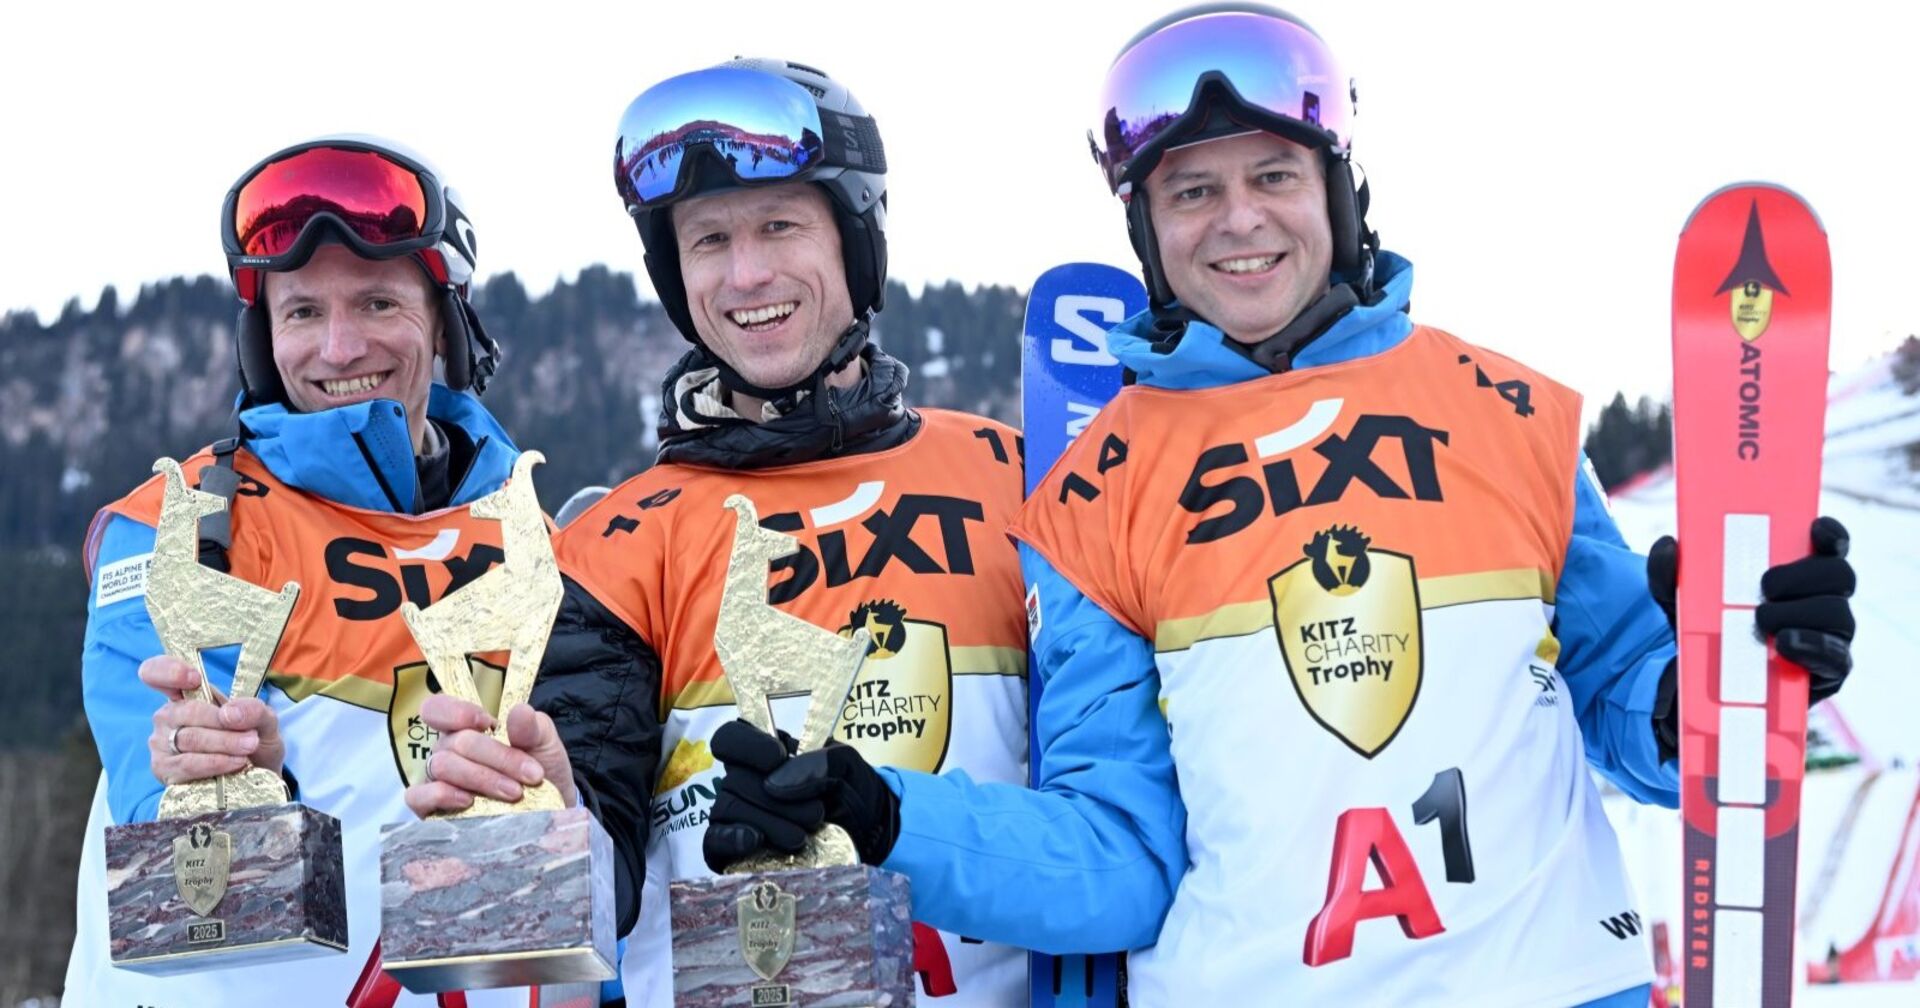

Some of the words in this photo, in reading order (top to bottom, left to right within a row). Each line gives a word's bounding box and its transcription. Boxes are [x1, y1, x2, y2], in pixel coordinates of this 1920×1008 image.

[1738, 341, 1762, 461] ATOMIC
[102, 571, 114, 581] FIS
[114, 562, 143, 577] ALPINE
[102, 576, 129, 590] WORLD
[1299, 616, 1358, 643] KITZ
[1304, 632, 1410, 664] CHARITY
[1306, 655, 1394, 686] Trophy
[842, 694, 942, 722] CHARITY
[842, 715, 927, 742] Trophy
[1303, 766, 1476, 968] A1
[1691, 859, 1711, 969] REDSTER
[193, 924, 218, 940] 2025
[757, 988, 784, 1004] 2025
